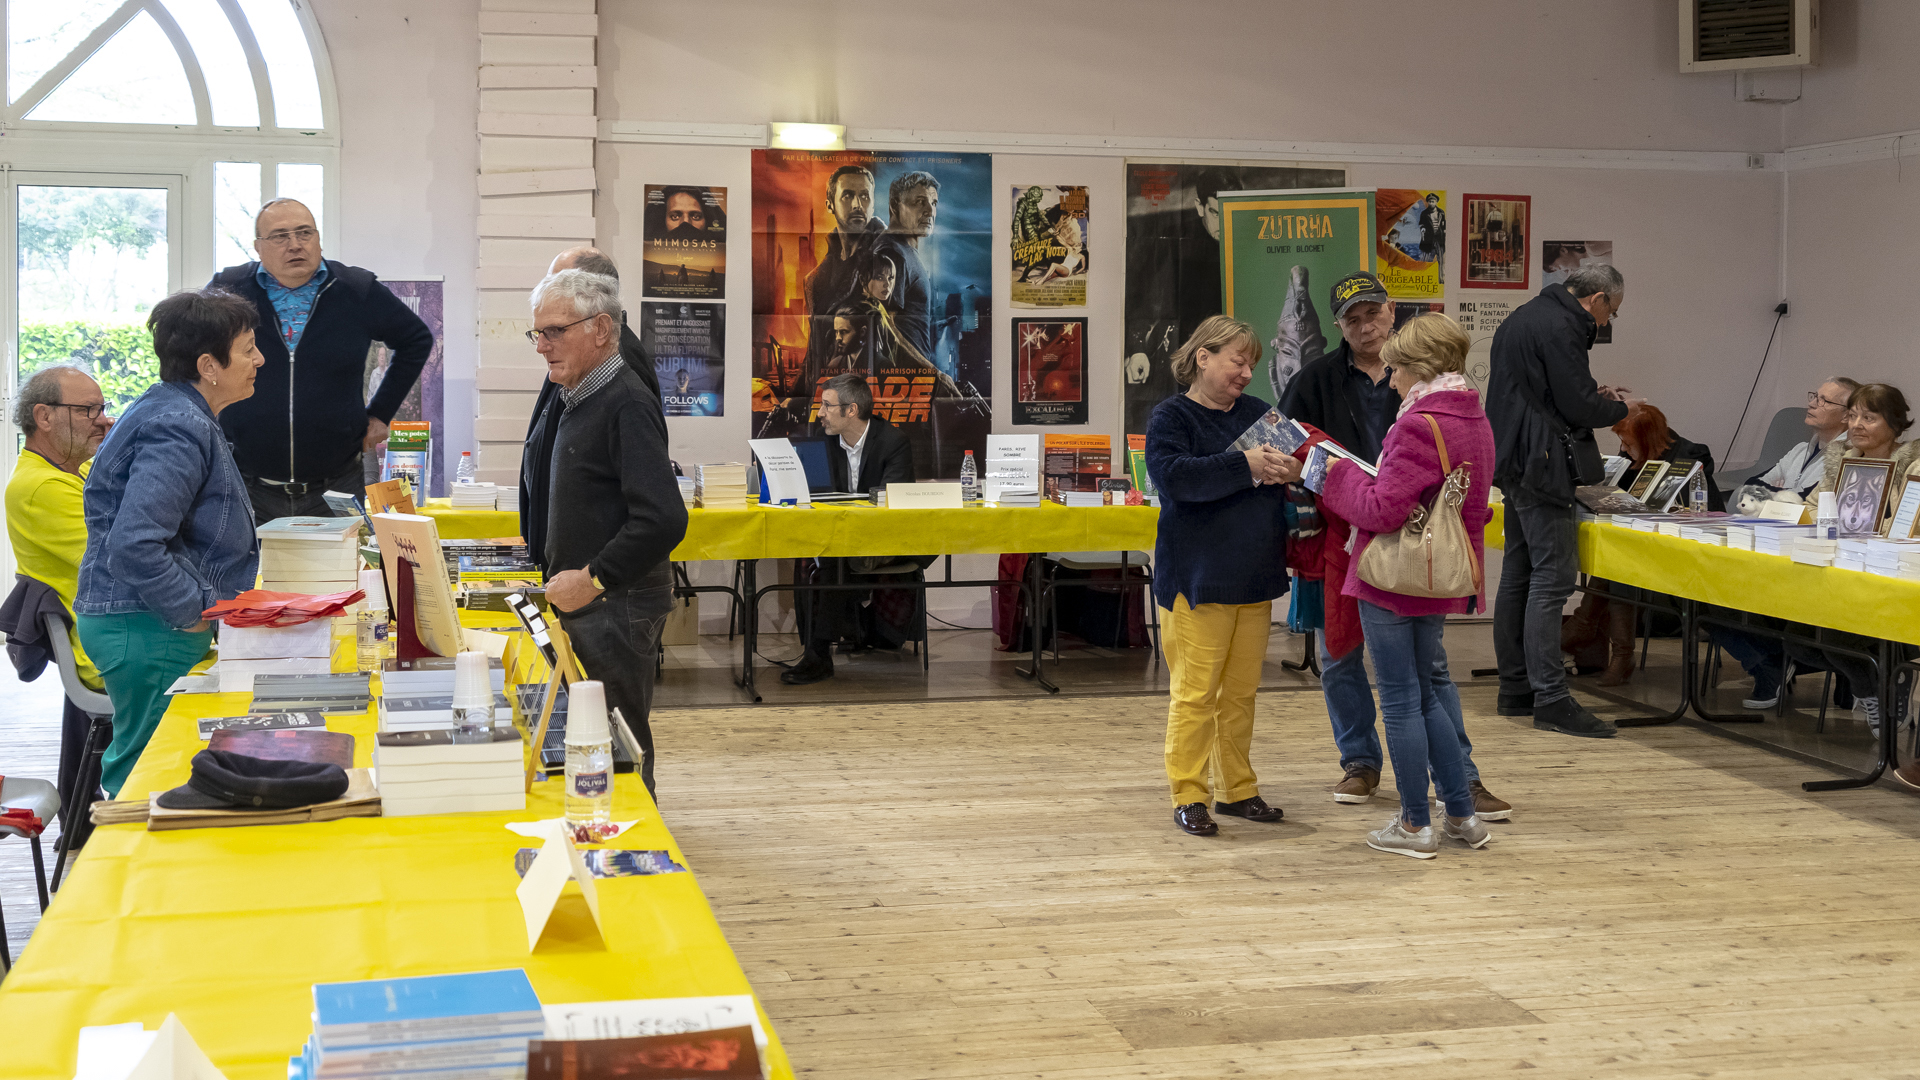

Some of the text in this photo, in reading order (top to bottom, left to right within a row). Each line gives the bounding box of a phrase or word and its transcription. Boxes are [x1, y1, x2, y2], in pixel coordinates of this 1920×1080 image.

[1257, 214, 1333, 240] ZUTRHA
[654, 238, 716, 248] MIMOSAS
[1046, 246, 1066, 258] NOIR
[1479, 248, 1513, 263] 1984
[1377, 273, 1433, 284] DIRIGEABLE
[1416, 282, 1438, 293] VOLÉ
[1460, 302, 1477, 312] MCL
[667, 334, 711, 344] CONSÉCRATION
[655, 345, 710, 354] ULTRA FLIPPANT
[664, 396, 709, 404] FOLLOWS
[1026, 406, 1075, 414] EXCALIBUR
[577, 778, 606, 787] JOLIVAL
